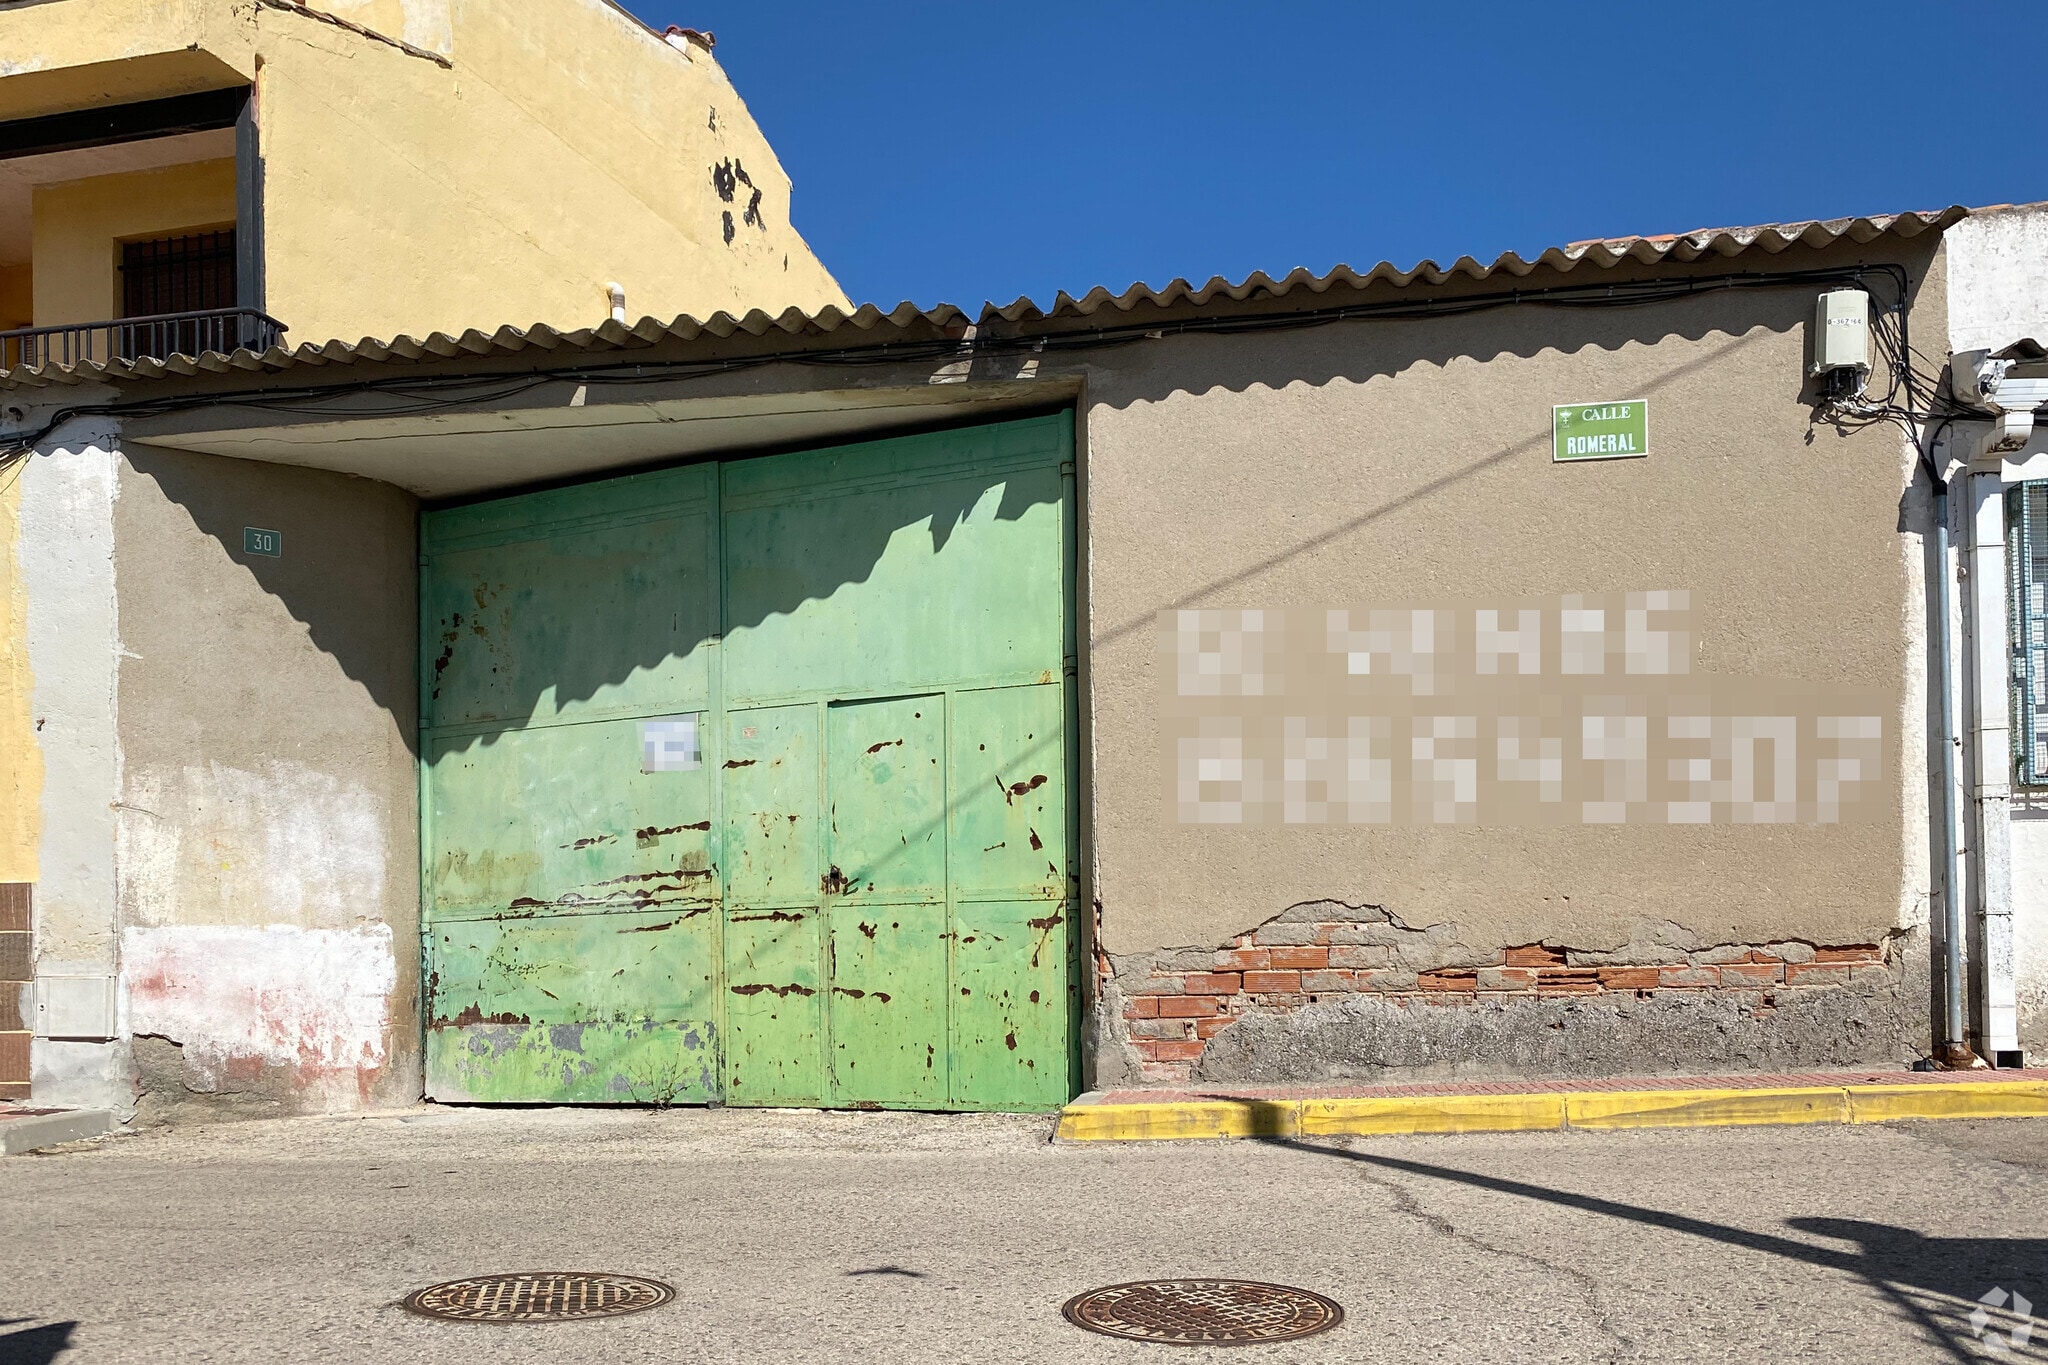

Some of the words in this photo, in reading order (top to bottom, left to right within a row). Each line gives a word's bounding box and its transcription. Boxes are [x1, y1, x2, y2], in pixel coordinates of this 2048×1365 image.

[1581, 406, 1631, 421] CALLE
[1567, 433, 1637, 455] ROMERAL
[254, 533, 272, 551] 30
